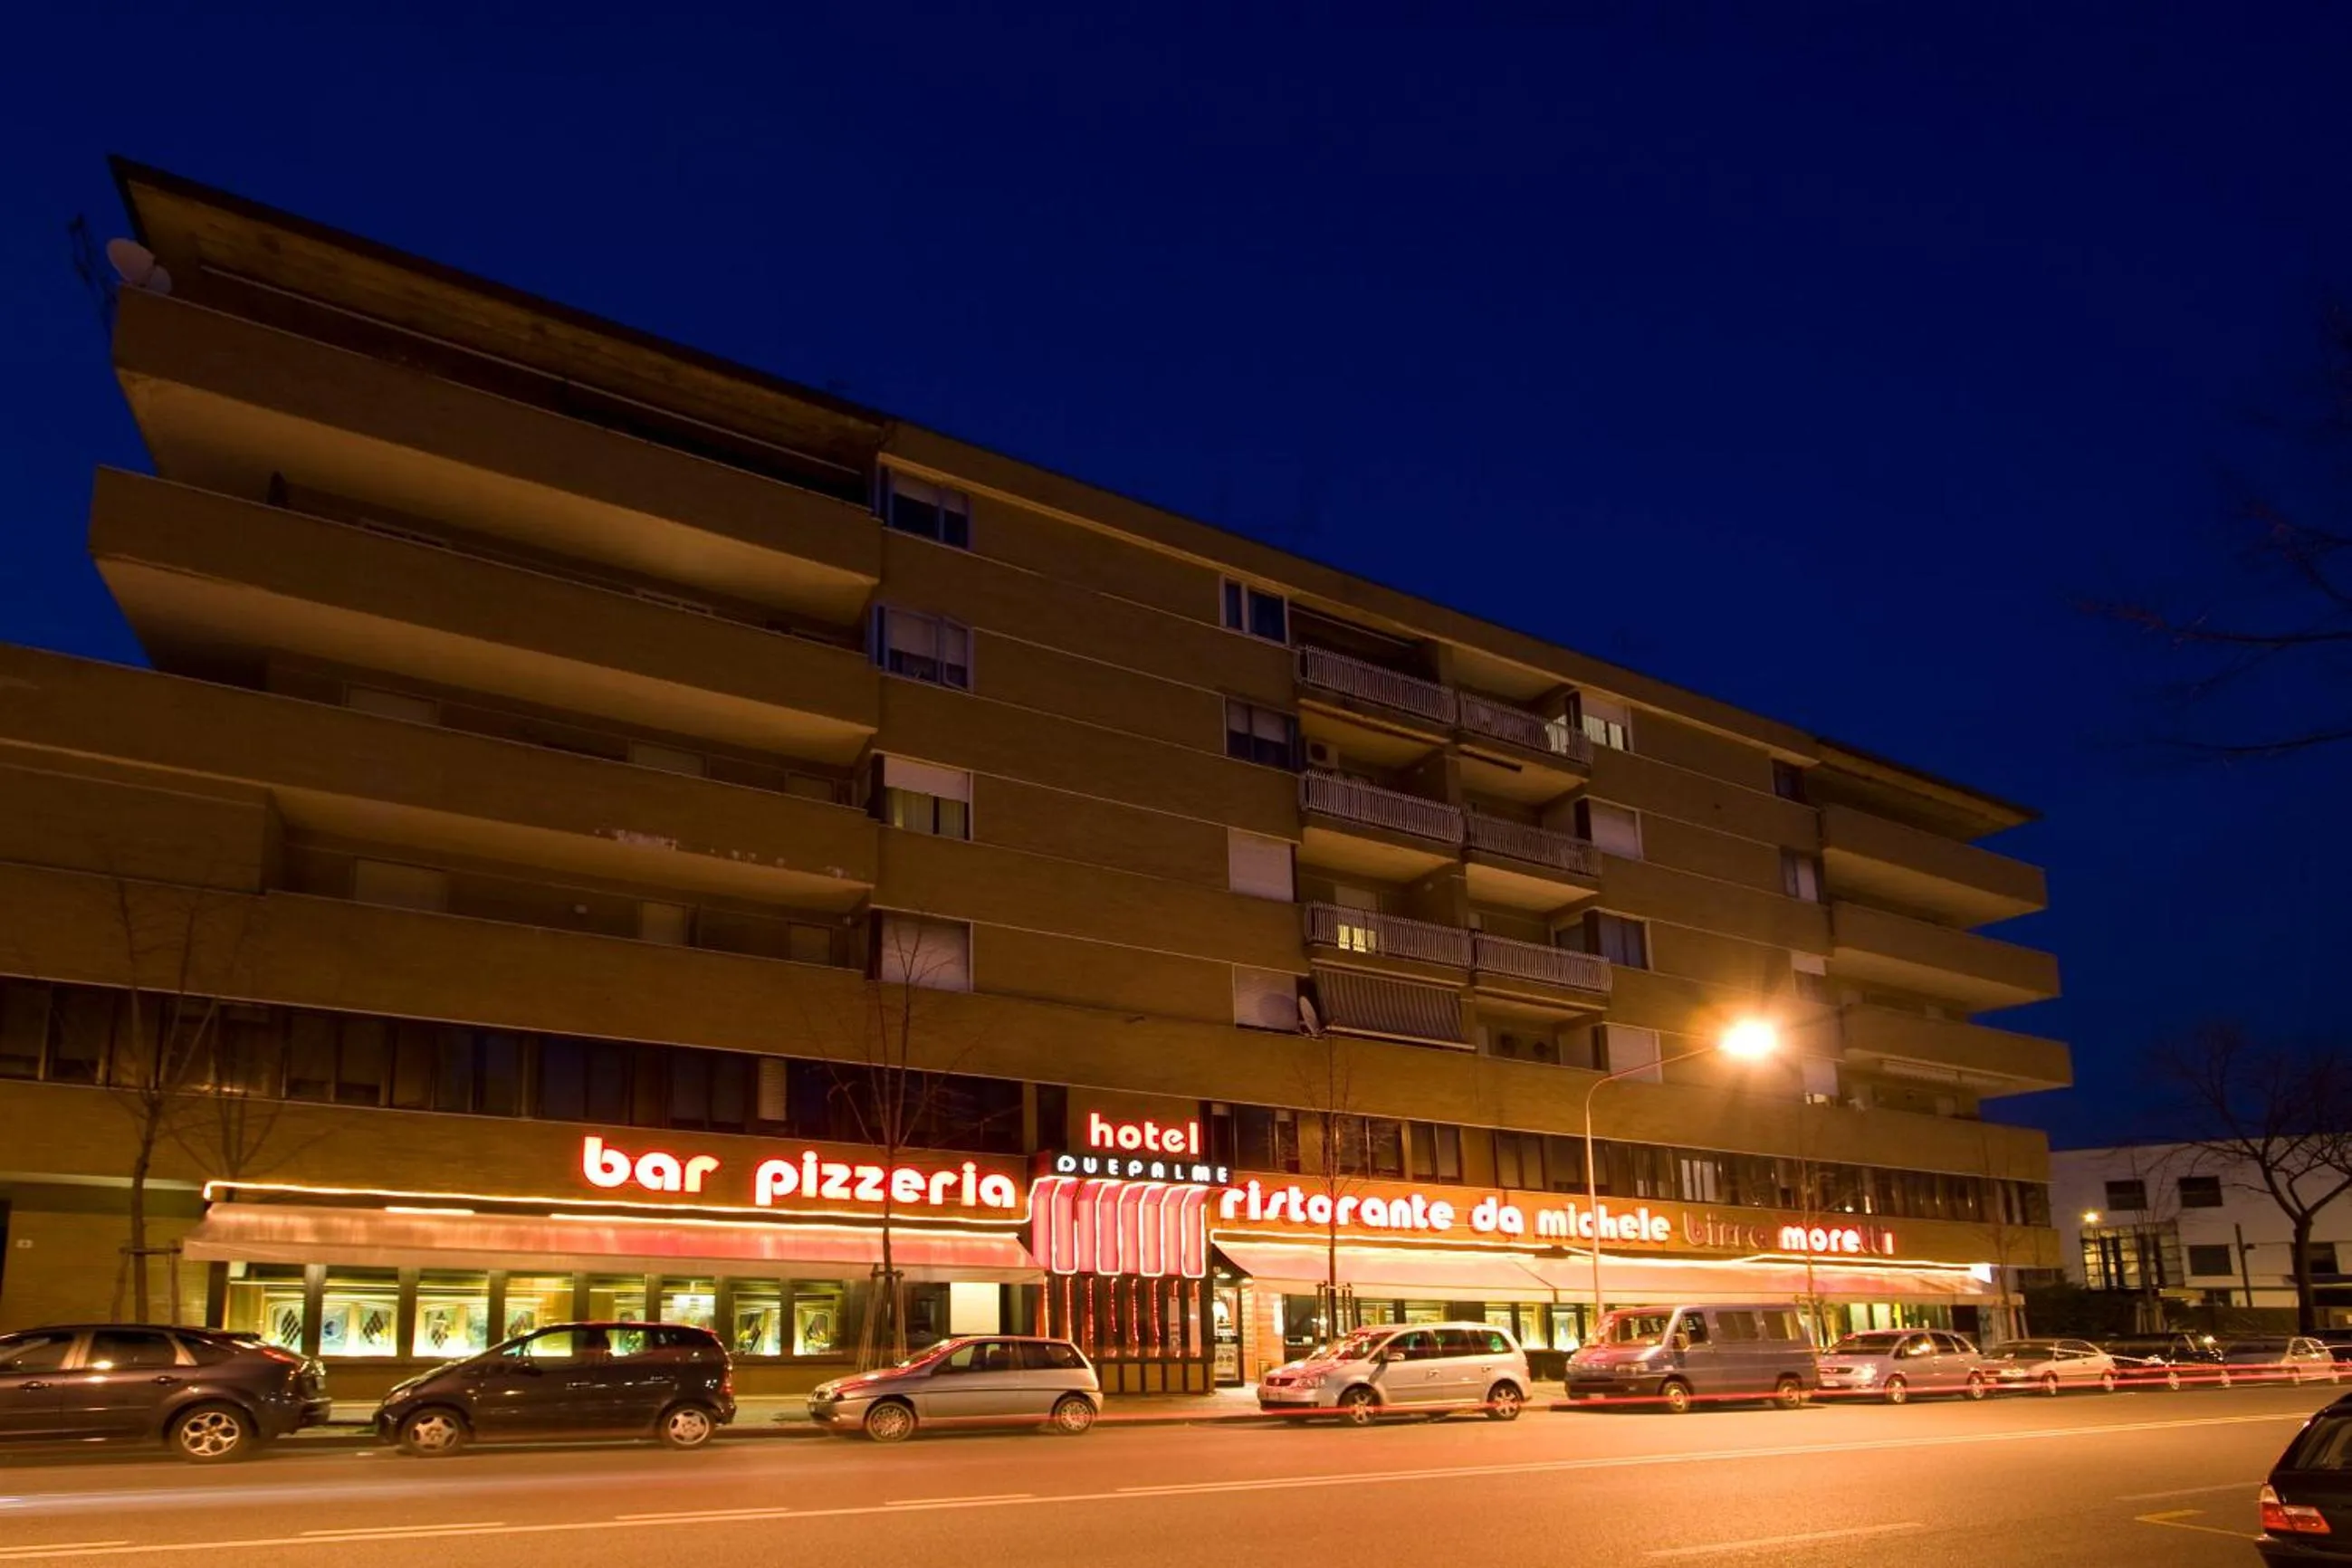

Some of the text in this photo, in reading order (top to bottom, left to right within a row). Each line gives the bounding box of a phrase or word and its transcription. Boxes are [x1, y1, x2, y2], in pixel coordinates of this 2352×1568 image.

[1090, 1113, 1199, 1154] hotel
[583, 1136, 1016, 1208] bar pizzeria
[1219, 1180, 1455, 1230] ristorante
[1472, 1196, 1525, 1235] da
[1538, 1202, 1671, 1241] michele
[1682, 1210, 1770, 1248] birra
